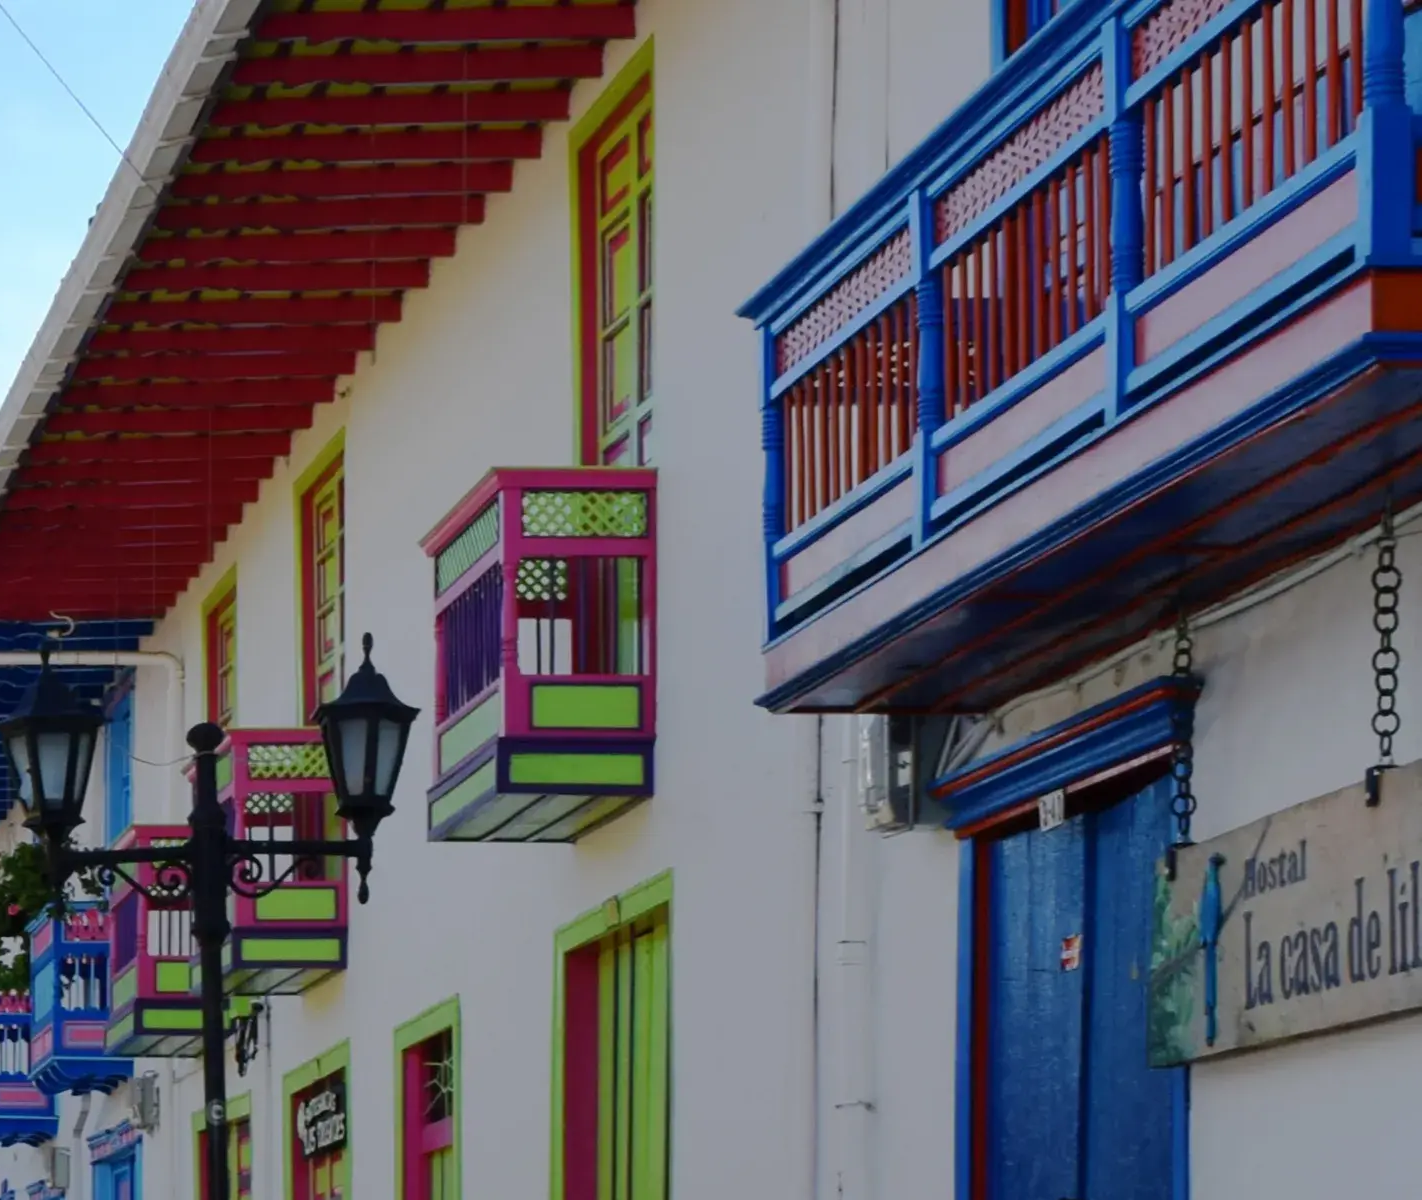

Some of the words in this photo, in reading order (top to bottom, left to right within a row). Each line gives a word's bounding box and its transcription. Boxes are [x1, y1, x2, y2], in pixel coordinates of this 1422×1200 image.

[1244, 839, 1307, 899] Hostal
[1243, 910, 1274, 1010] La
[1280, 920, 1341, 1000] casa
[1347, 876, 1382, 984] de
